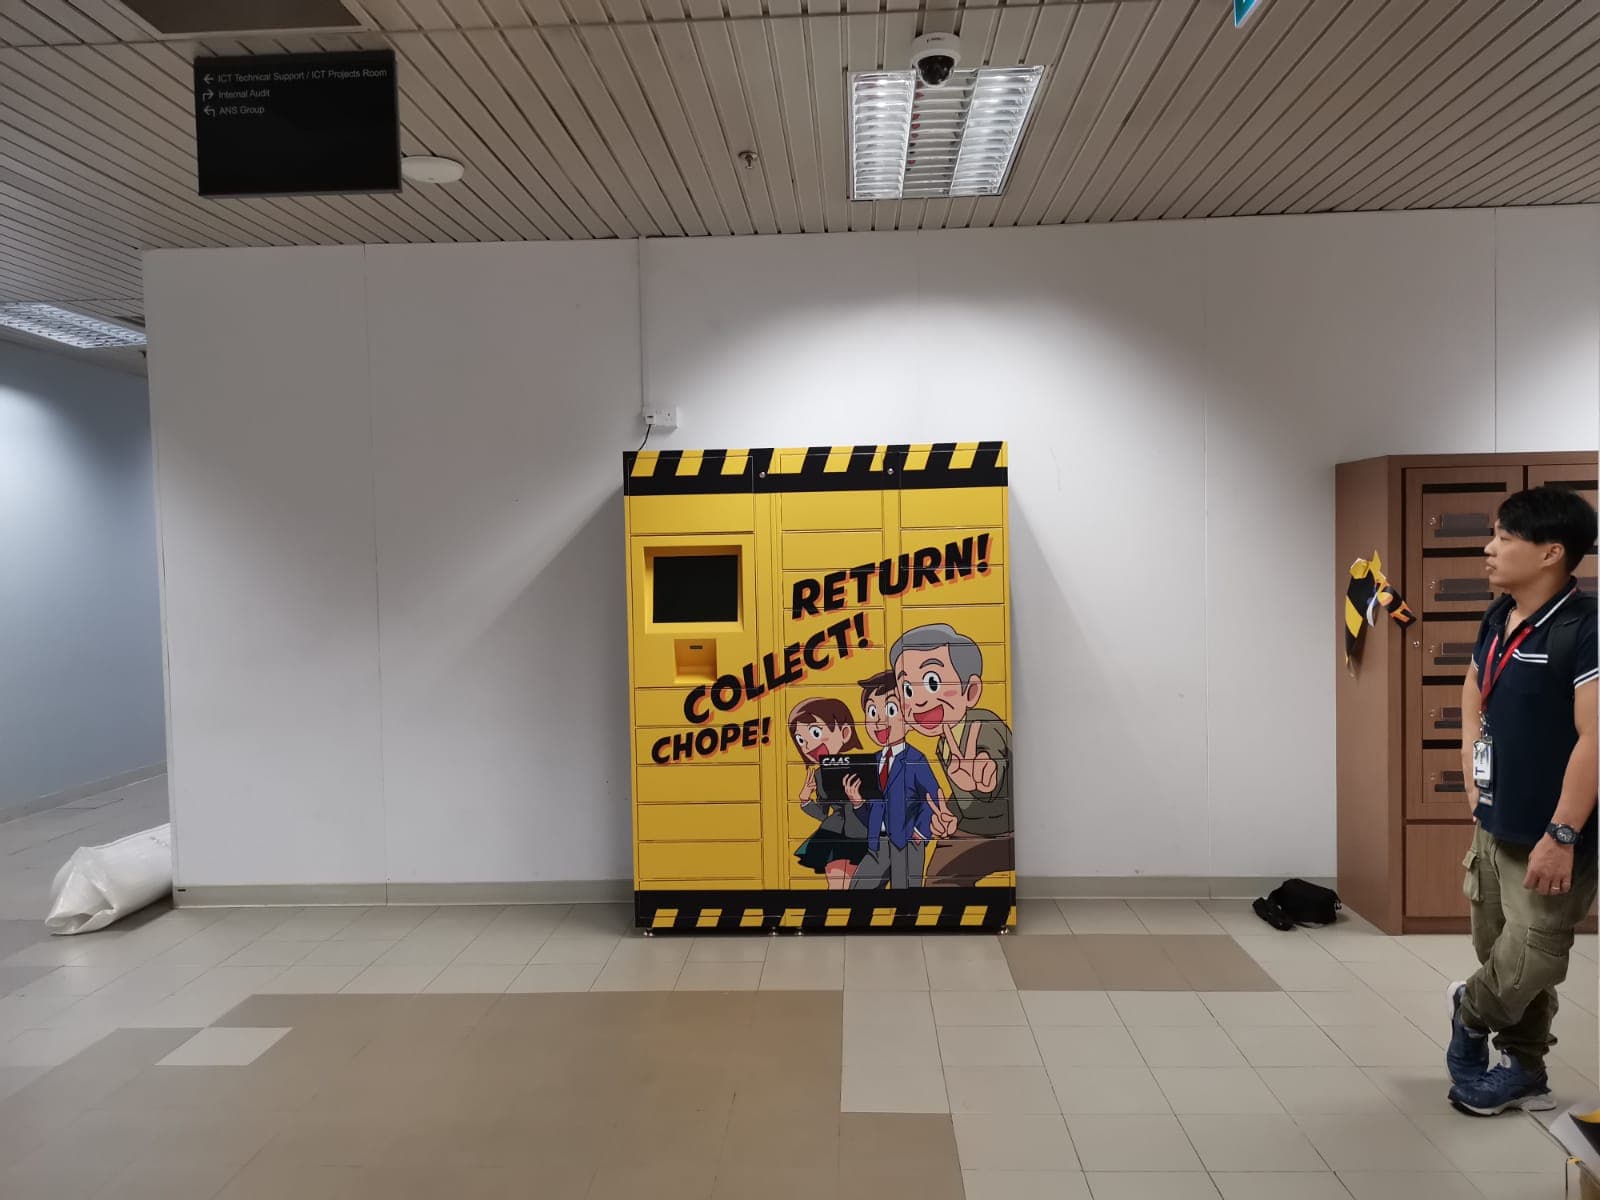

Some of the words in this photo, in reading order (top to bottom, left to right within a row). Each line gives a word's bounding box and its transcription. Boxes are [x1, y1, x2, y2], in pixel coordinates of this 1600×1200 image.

[217, 73, 232, 82] ICT
[235, 72, 271, 82] Technical
[273, 71, 305, 83] Support
[311, 70, 326, 79] ICT
[327, 69, 360, 81] Projects
[362, 68, 388, 78] Room
[218, 90, 248, 99] Internal
[249, 88, 271, 98] Audit
[219, 105, 238, 115] ANS
[239, 105, 265, 115] Group
[791, 533, 992, 620] RETURN!
[683, 611, 870, 724] COLLECT!
[651, 716, 772, 765] CHOPE!
[822, 756, 851, 766] CAAS
